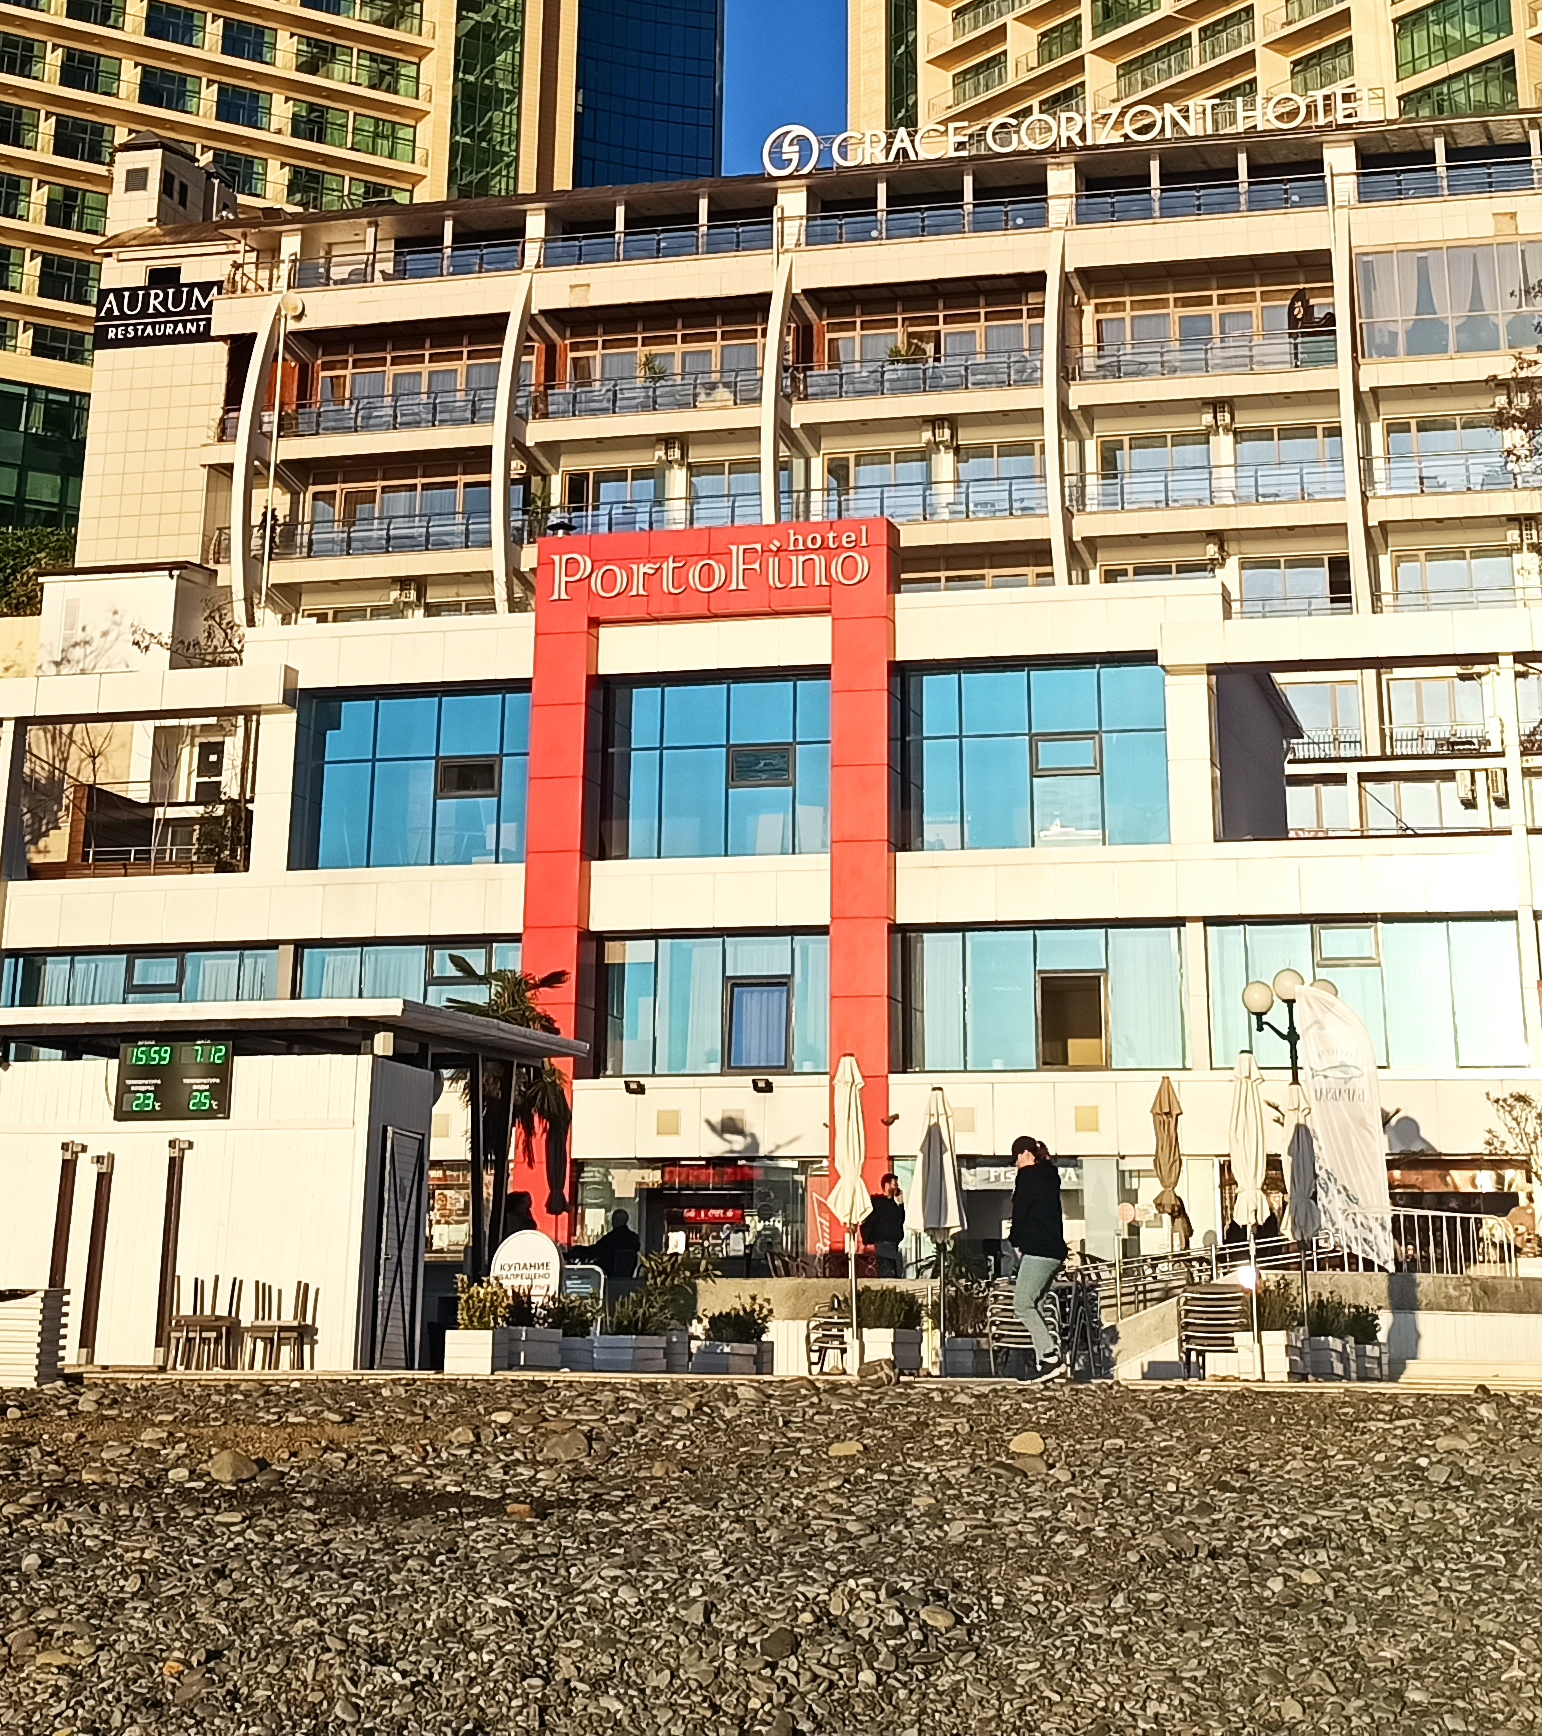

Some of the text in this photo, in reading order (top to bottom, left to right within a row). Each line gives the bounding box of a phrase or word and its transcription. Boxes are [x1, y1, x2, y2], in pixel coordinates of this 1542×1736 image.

[831, 86, 1381, 168] GRACE GORIZONT HOTEL
[99, 285, 218, 317] AURUM
[107, 320, 207, 340] RESTAURANT
[788, 526, 869, 551] hotel
[549, 539, 871, 602] PortoFino
[132, 1093, 155, 1111] 23
[189, 1092, 211, 1110] 25
[500, 1261, 551, 1272] КУПАНИЕ
[500, 1272, 551, 1281] ЗАПРЕЩЕНО
